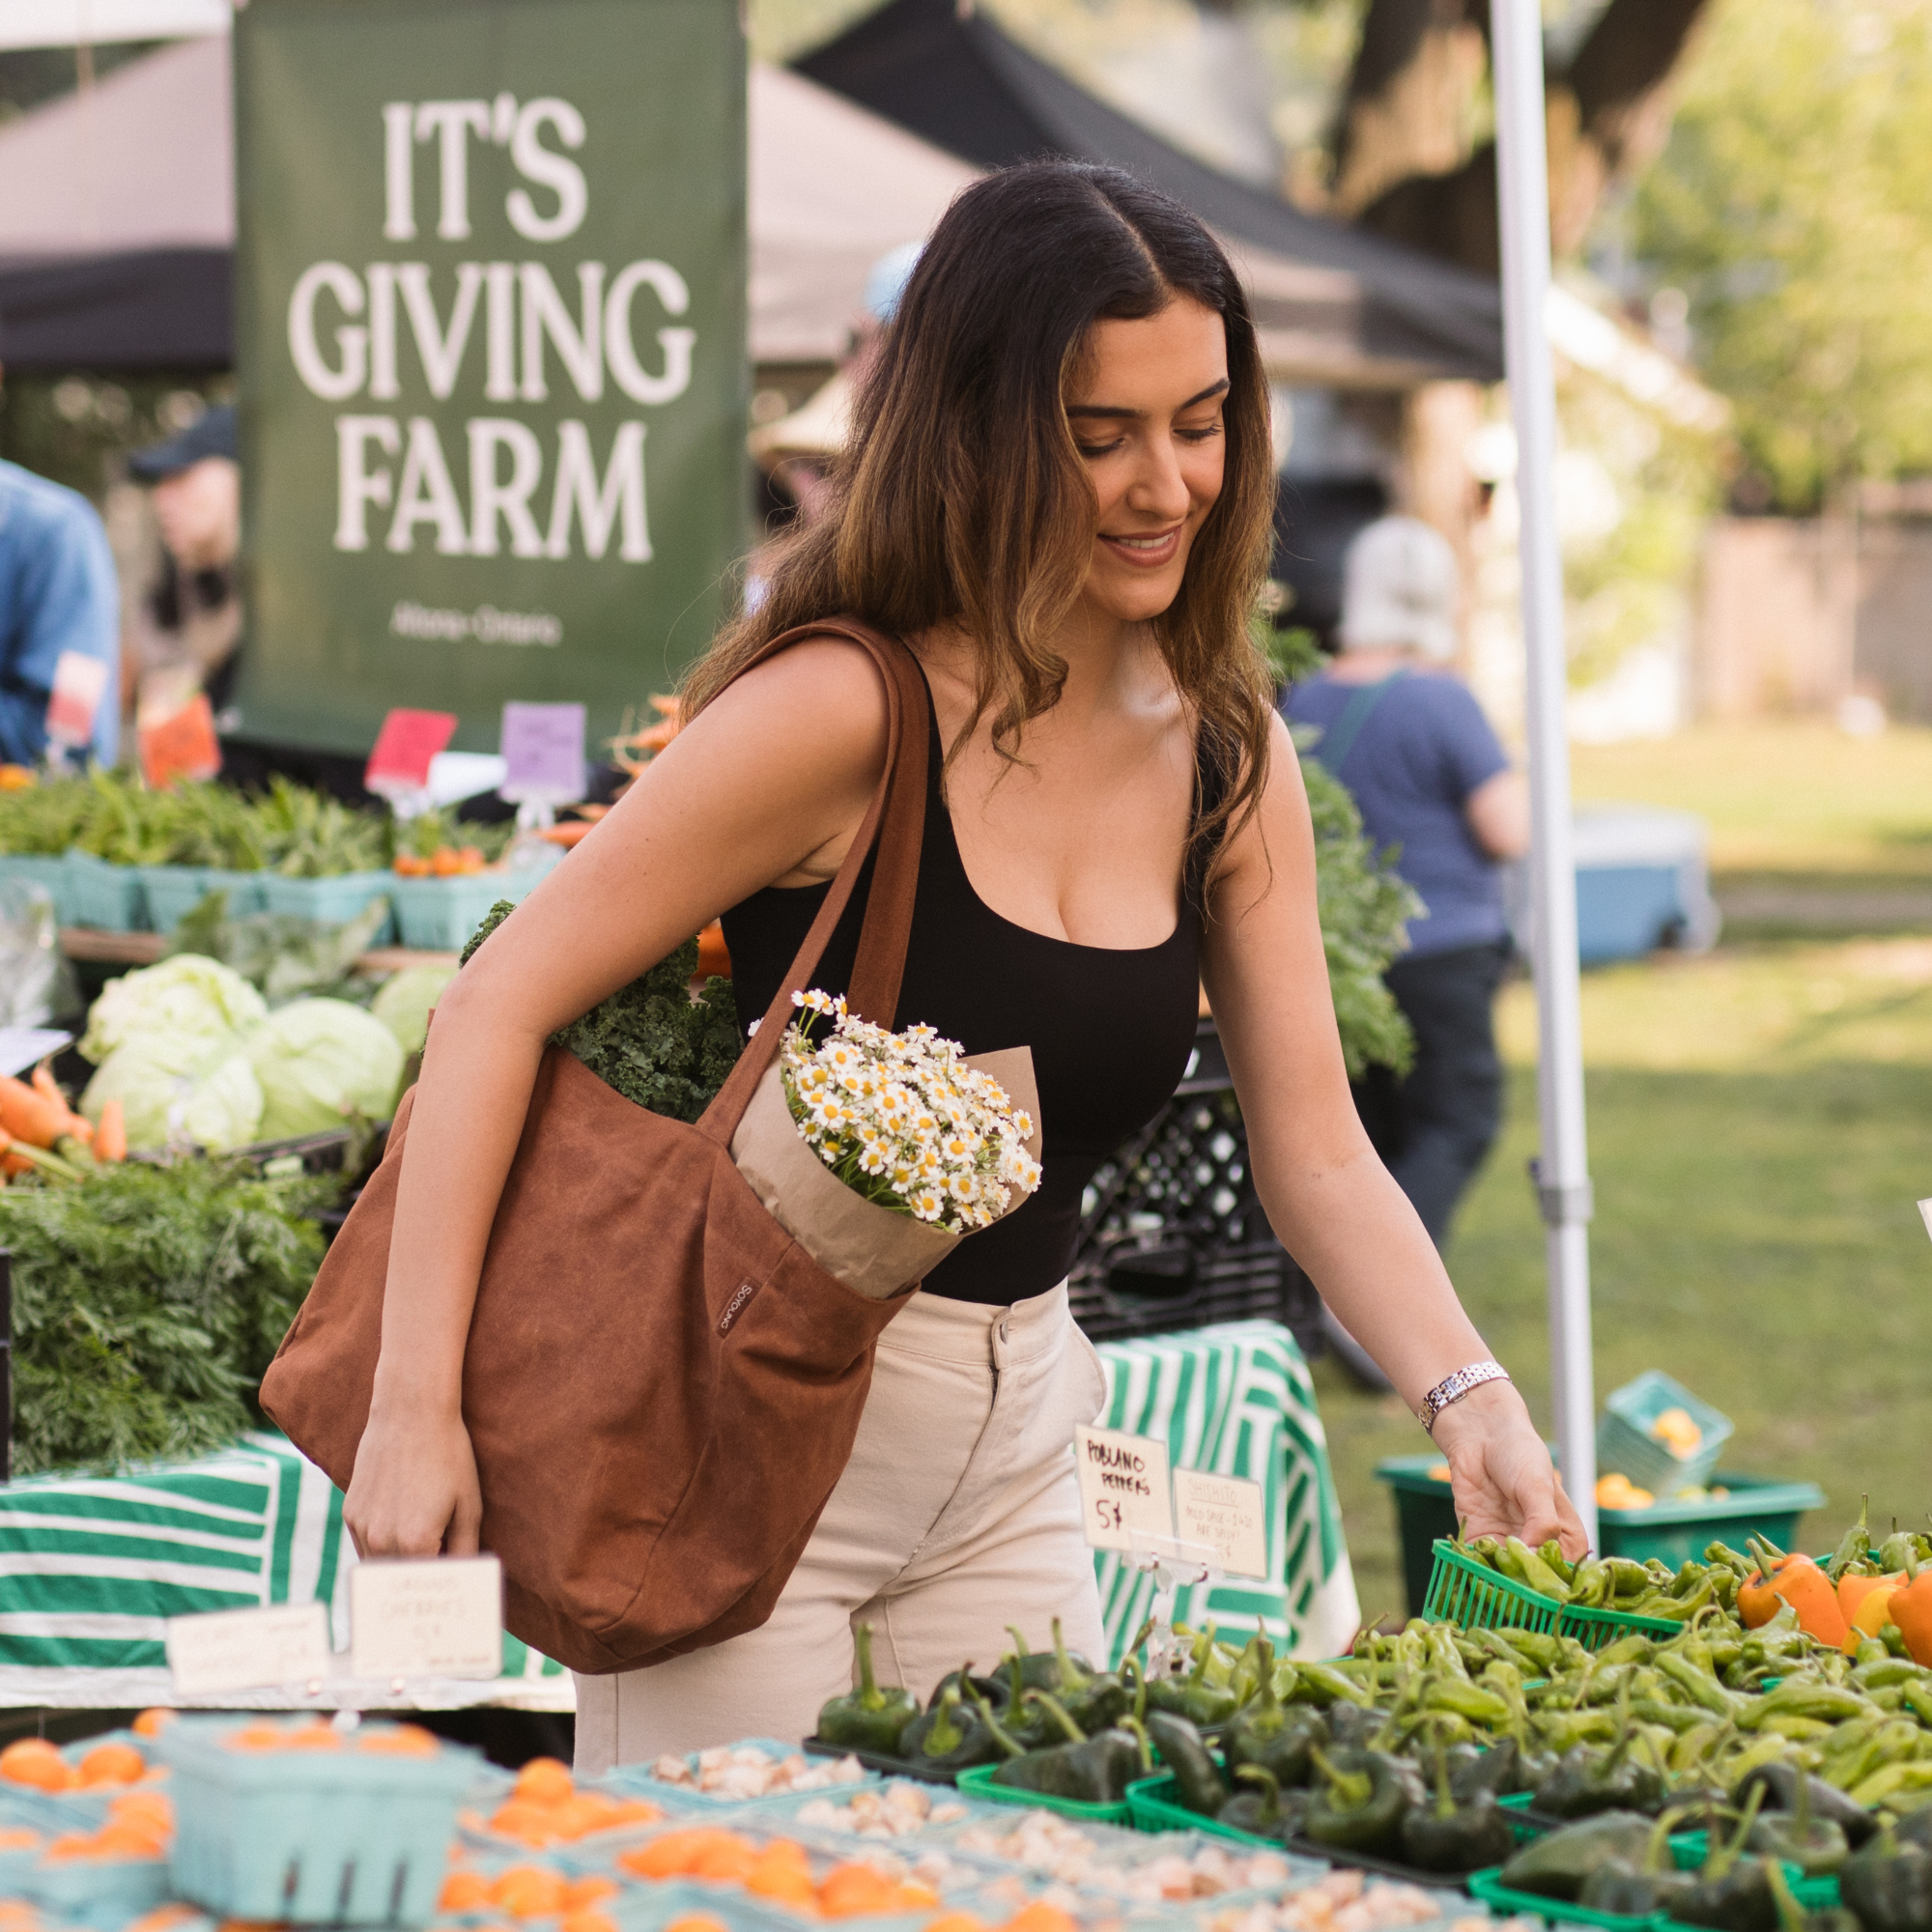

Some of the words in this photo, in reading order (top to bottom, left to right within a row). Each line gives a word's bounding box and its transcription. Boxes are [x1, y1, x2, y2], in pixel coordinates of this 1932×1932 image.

[383, 93, 587, 242] IT'S
[289, 259, 696, 405] GIVING
[334, 415, 653, 562] FARM
[1087, 1439, 1146, 1473] POBLANO
[1188, 1478, 1236, 1504] SHISHITO
[1196, 1522, 1211, 1537] ARE
[1207, 1509, 1225, 1524] SPICE
